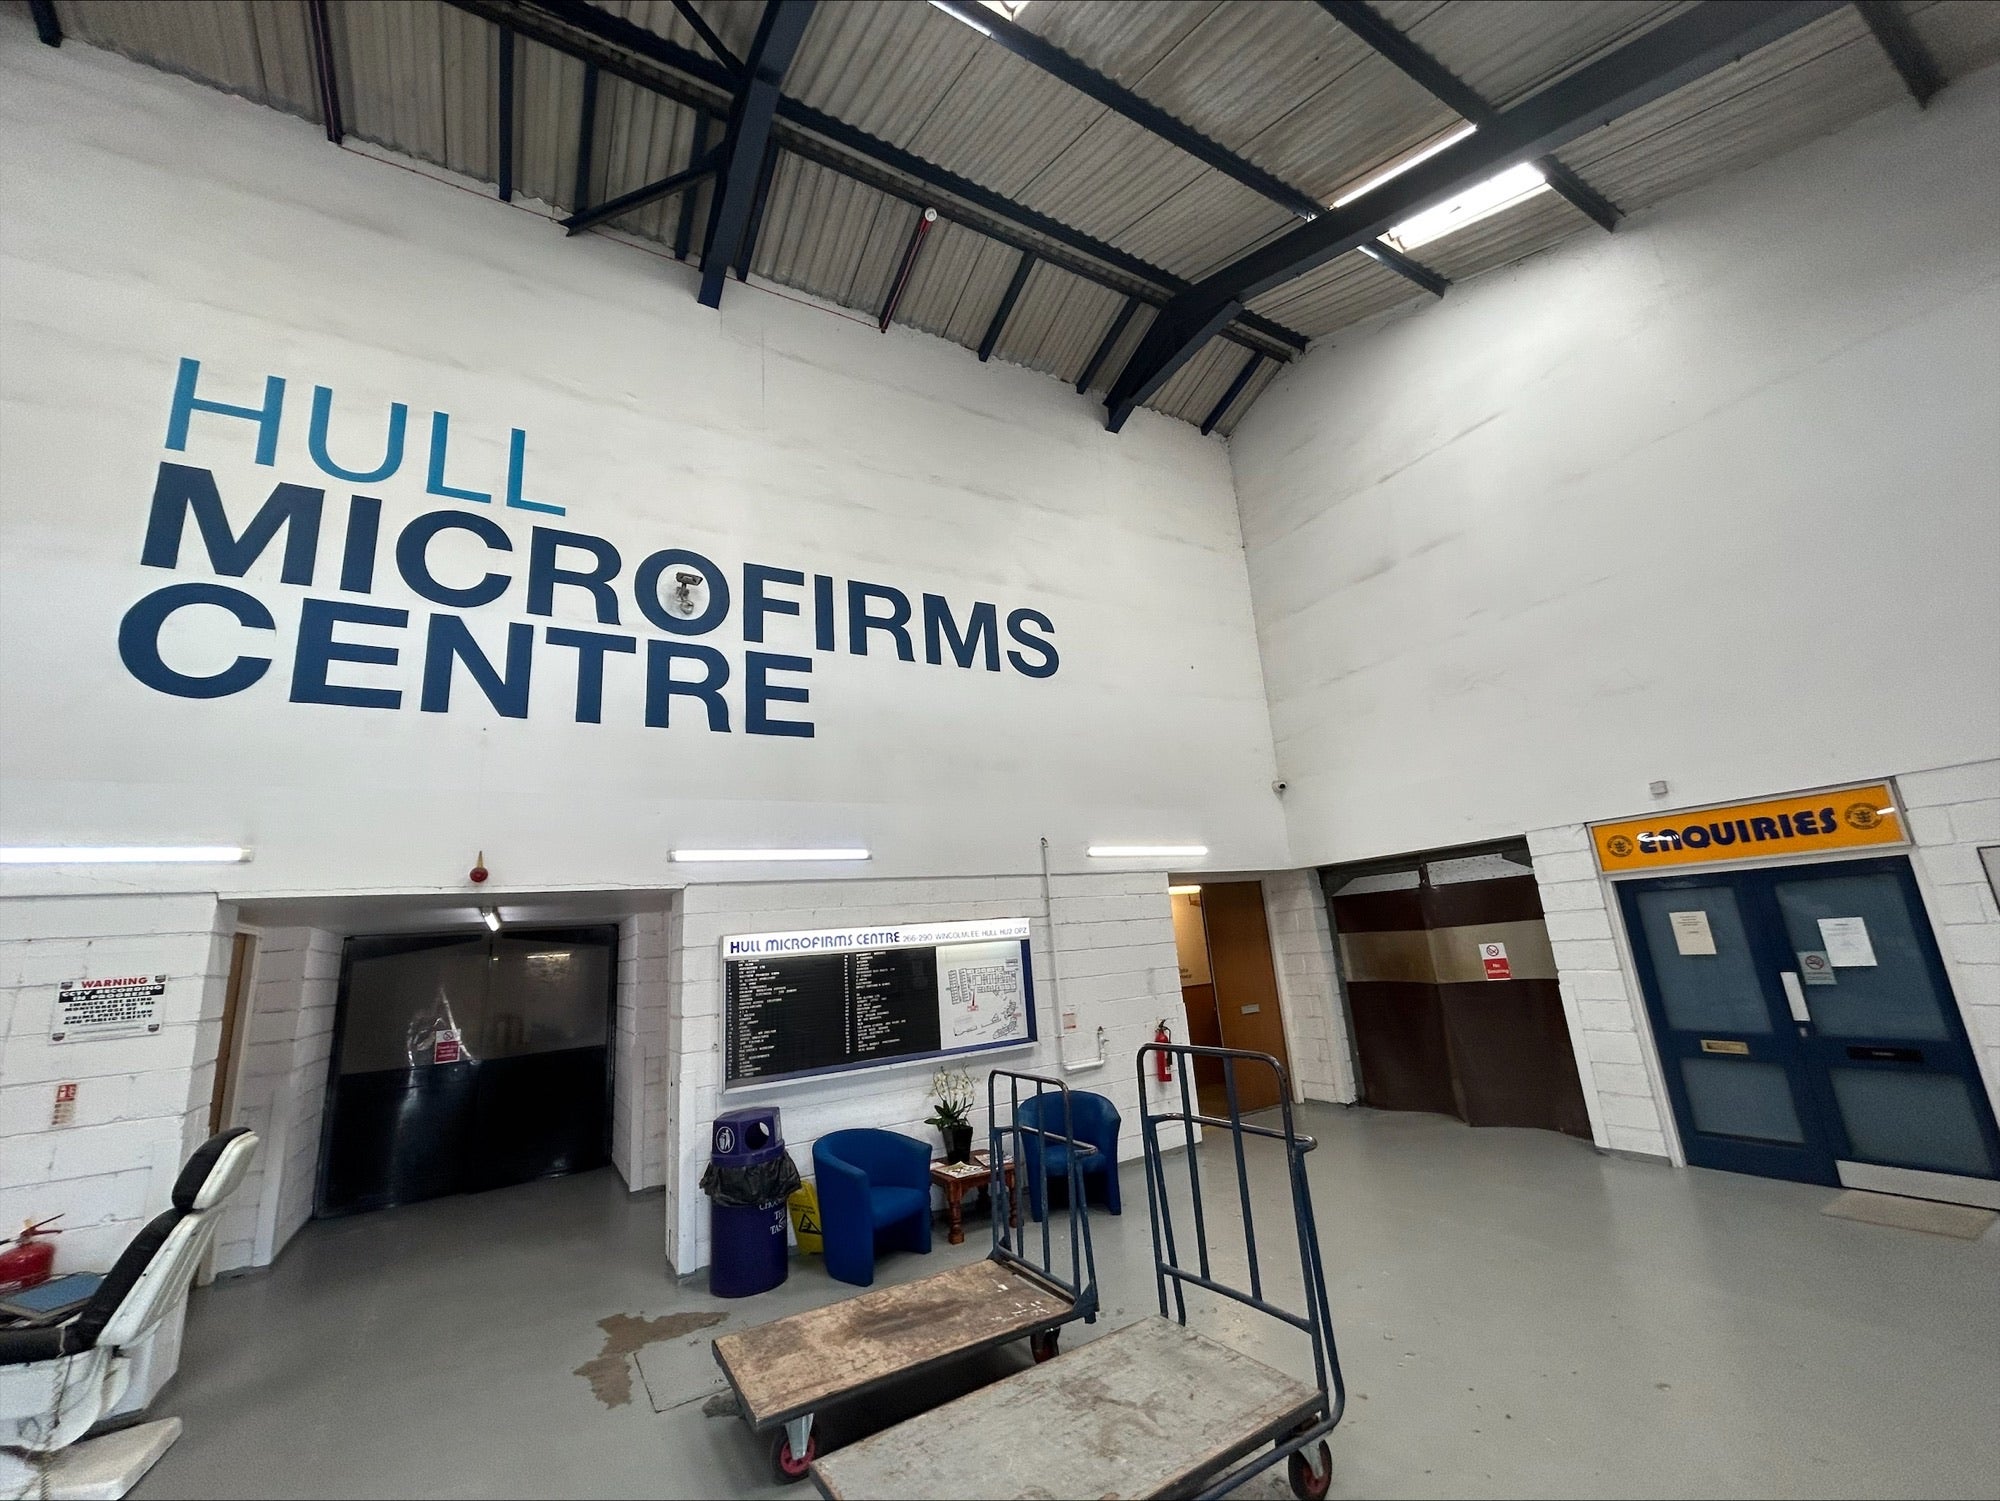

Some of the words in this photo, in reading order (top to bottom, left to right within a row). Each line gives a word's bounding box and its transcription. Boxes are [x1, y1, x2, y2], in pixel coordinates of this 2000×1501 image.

[165, 356, 566, 517] HULL
[140, 460, 1060, 679] MICROFIRMS
[118, 582, 815, 739] CENTRE
[1638, 807, 1838, 854] ENQUIRIES
[730, 940, 761, 953] HULL
[765, 934, 853, 952] MICROFIRMS
[856, 931, 900, 945] CENTRE
[902, 933, 933, 943] 266-290
[981, 928, 997, 937] HULL
[81, 977, 148, 989] WARNING
[91, 991, 151, 1000] PROGRESS
[96, 985, 162, 995] RECORDING
